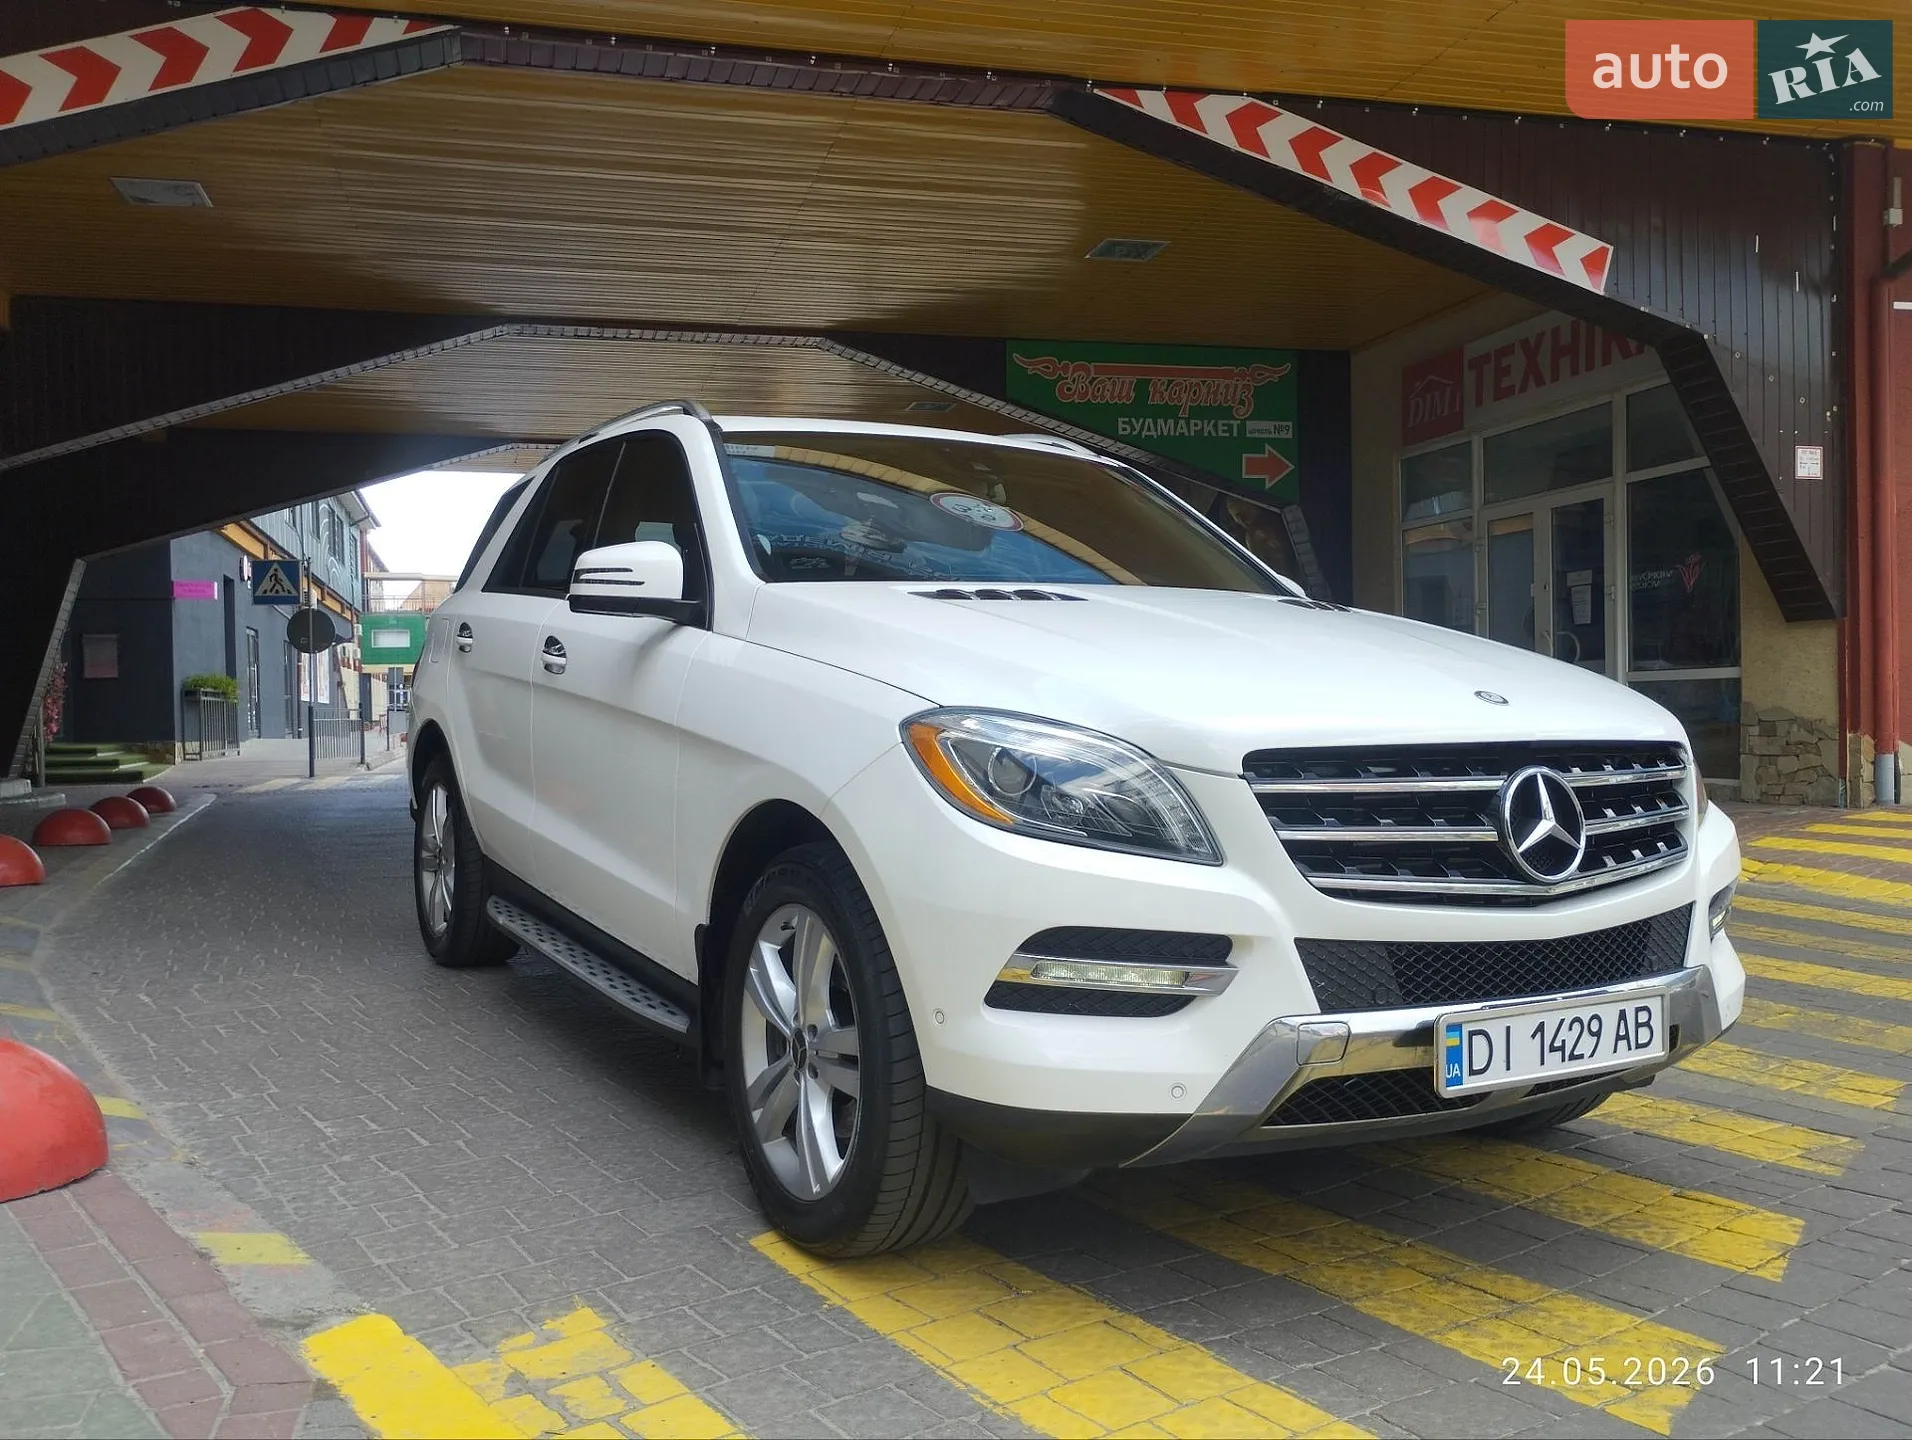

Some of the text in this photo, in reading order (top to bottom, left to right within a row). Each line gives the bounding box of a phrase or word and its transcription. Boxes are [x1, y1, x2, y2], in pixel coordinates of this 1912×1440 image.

[1056, 366, 1137, 404] Ваш
[1117, 418, 1241, 438] БУДМАРКЕТ
[1467, 1005, 1655, 1077] DI 1429 AB
